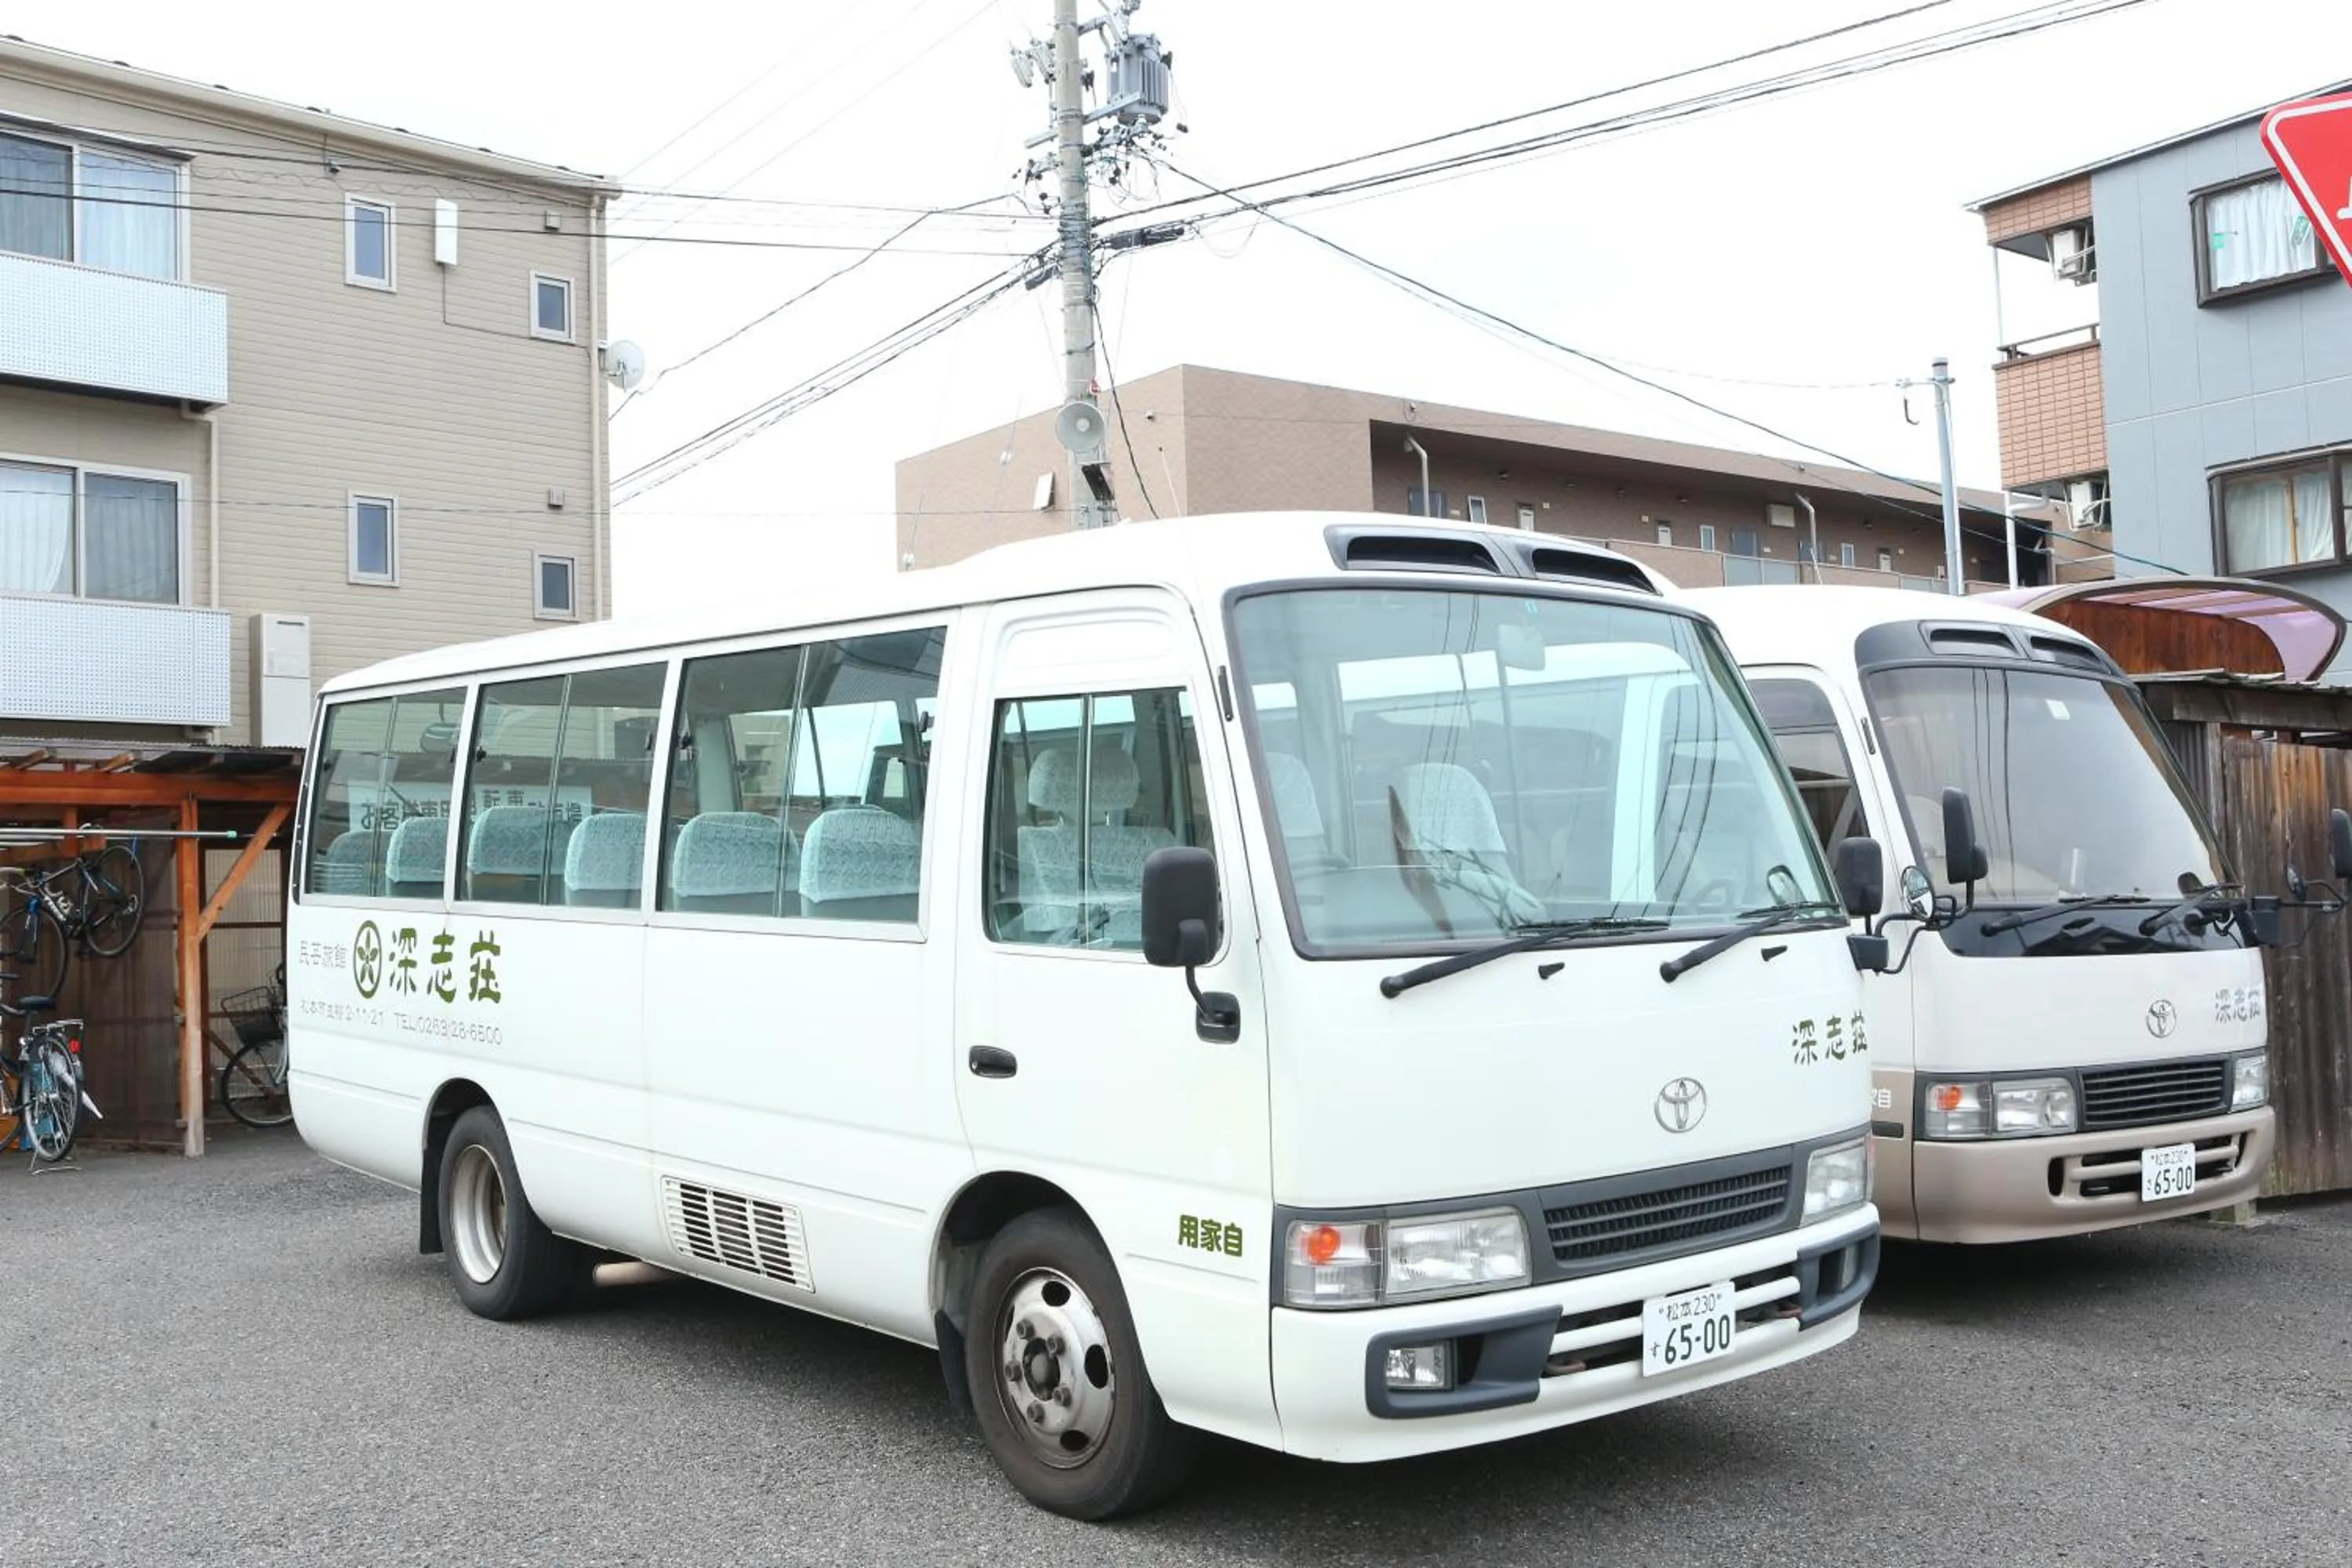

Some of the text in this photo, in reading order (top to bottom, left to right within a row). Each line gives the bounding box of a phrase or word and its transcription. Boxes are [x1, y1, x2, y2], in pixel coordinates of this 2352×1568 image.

[389, 927, 502, 1004] 深志荘
[1791, 1009, 1868, 1065] 深志荘
[2154, 1166, 2193, 1196] 65-00
[1664, 1314, 1730, 1364] 65-00
